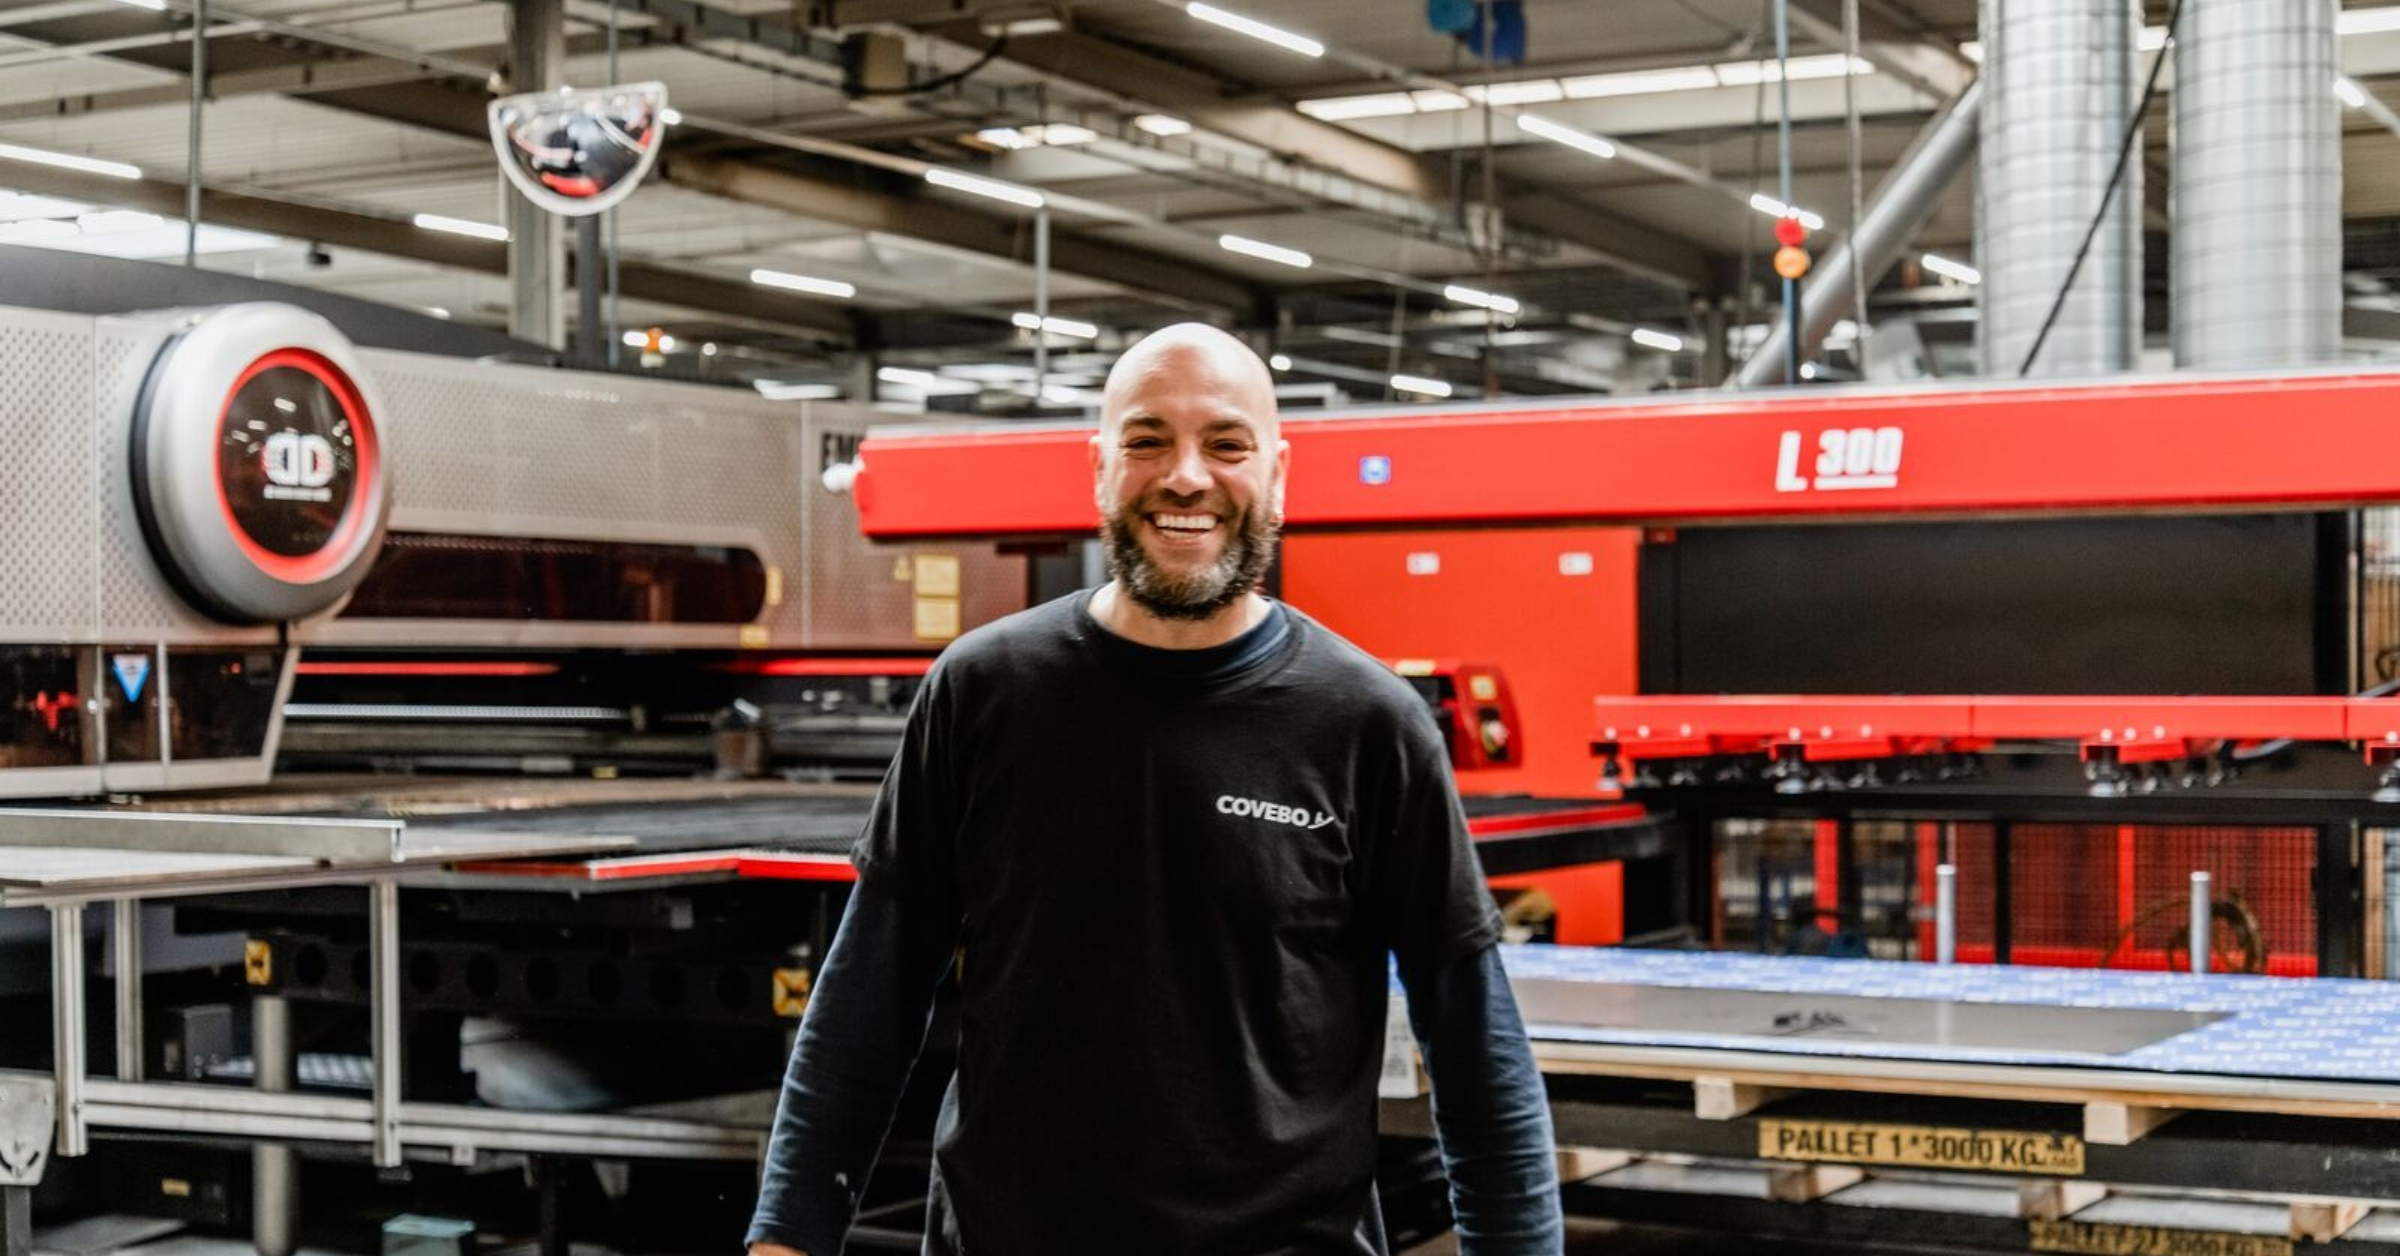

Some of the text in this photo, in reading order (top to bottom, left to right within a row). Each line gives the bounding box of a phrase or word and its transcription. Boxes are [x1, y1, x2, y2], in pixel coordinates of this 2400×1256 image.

[1775, 426, 1903, 492] L 300
[1216, 795, 1310, 827] COVEBO
[1779, 1127, 1877, 1156] PALLET
